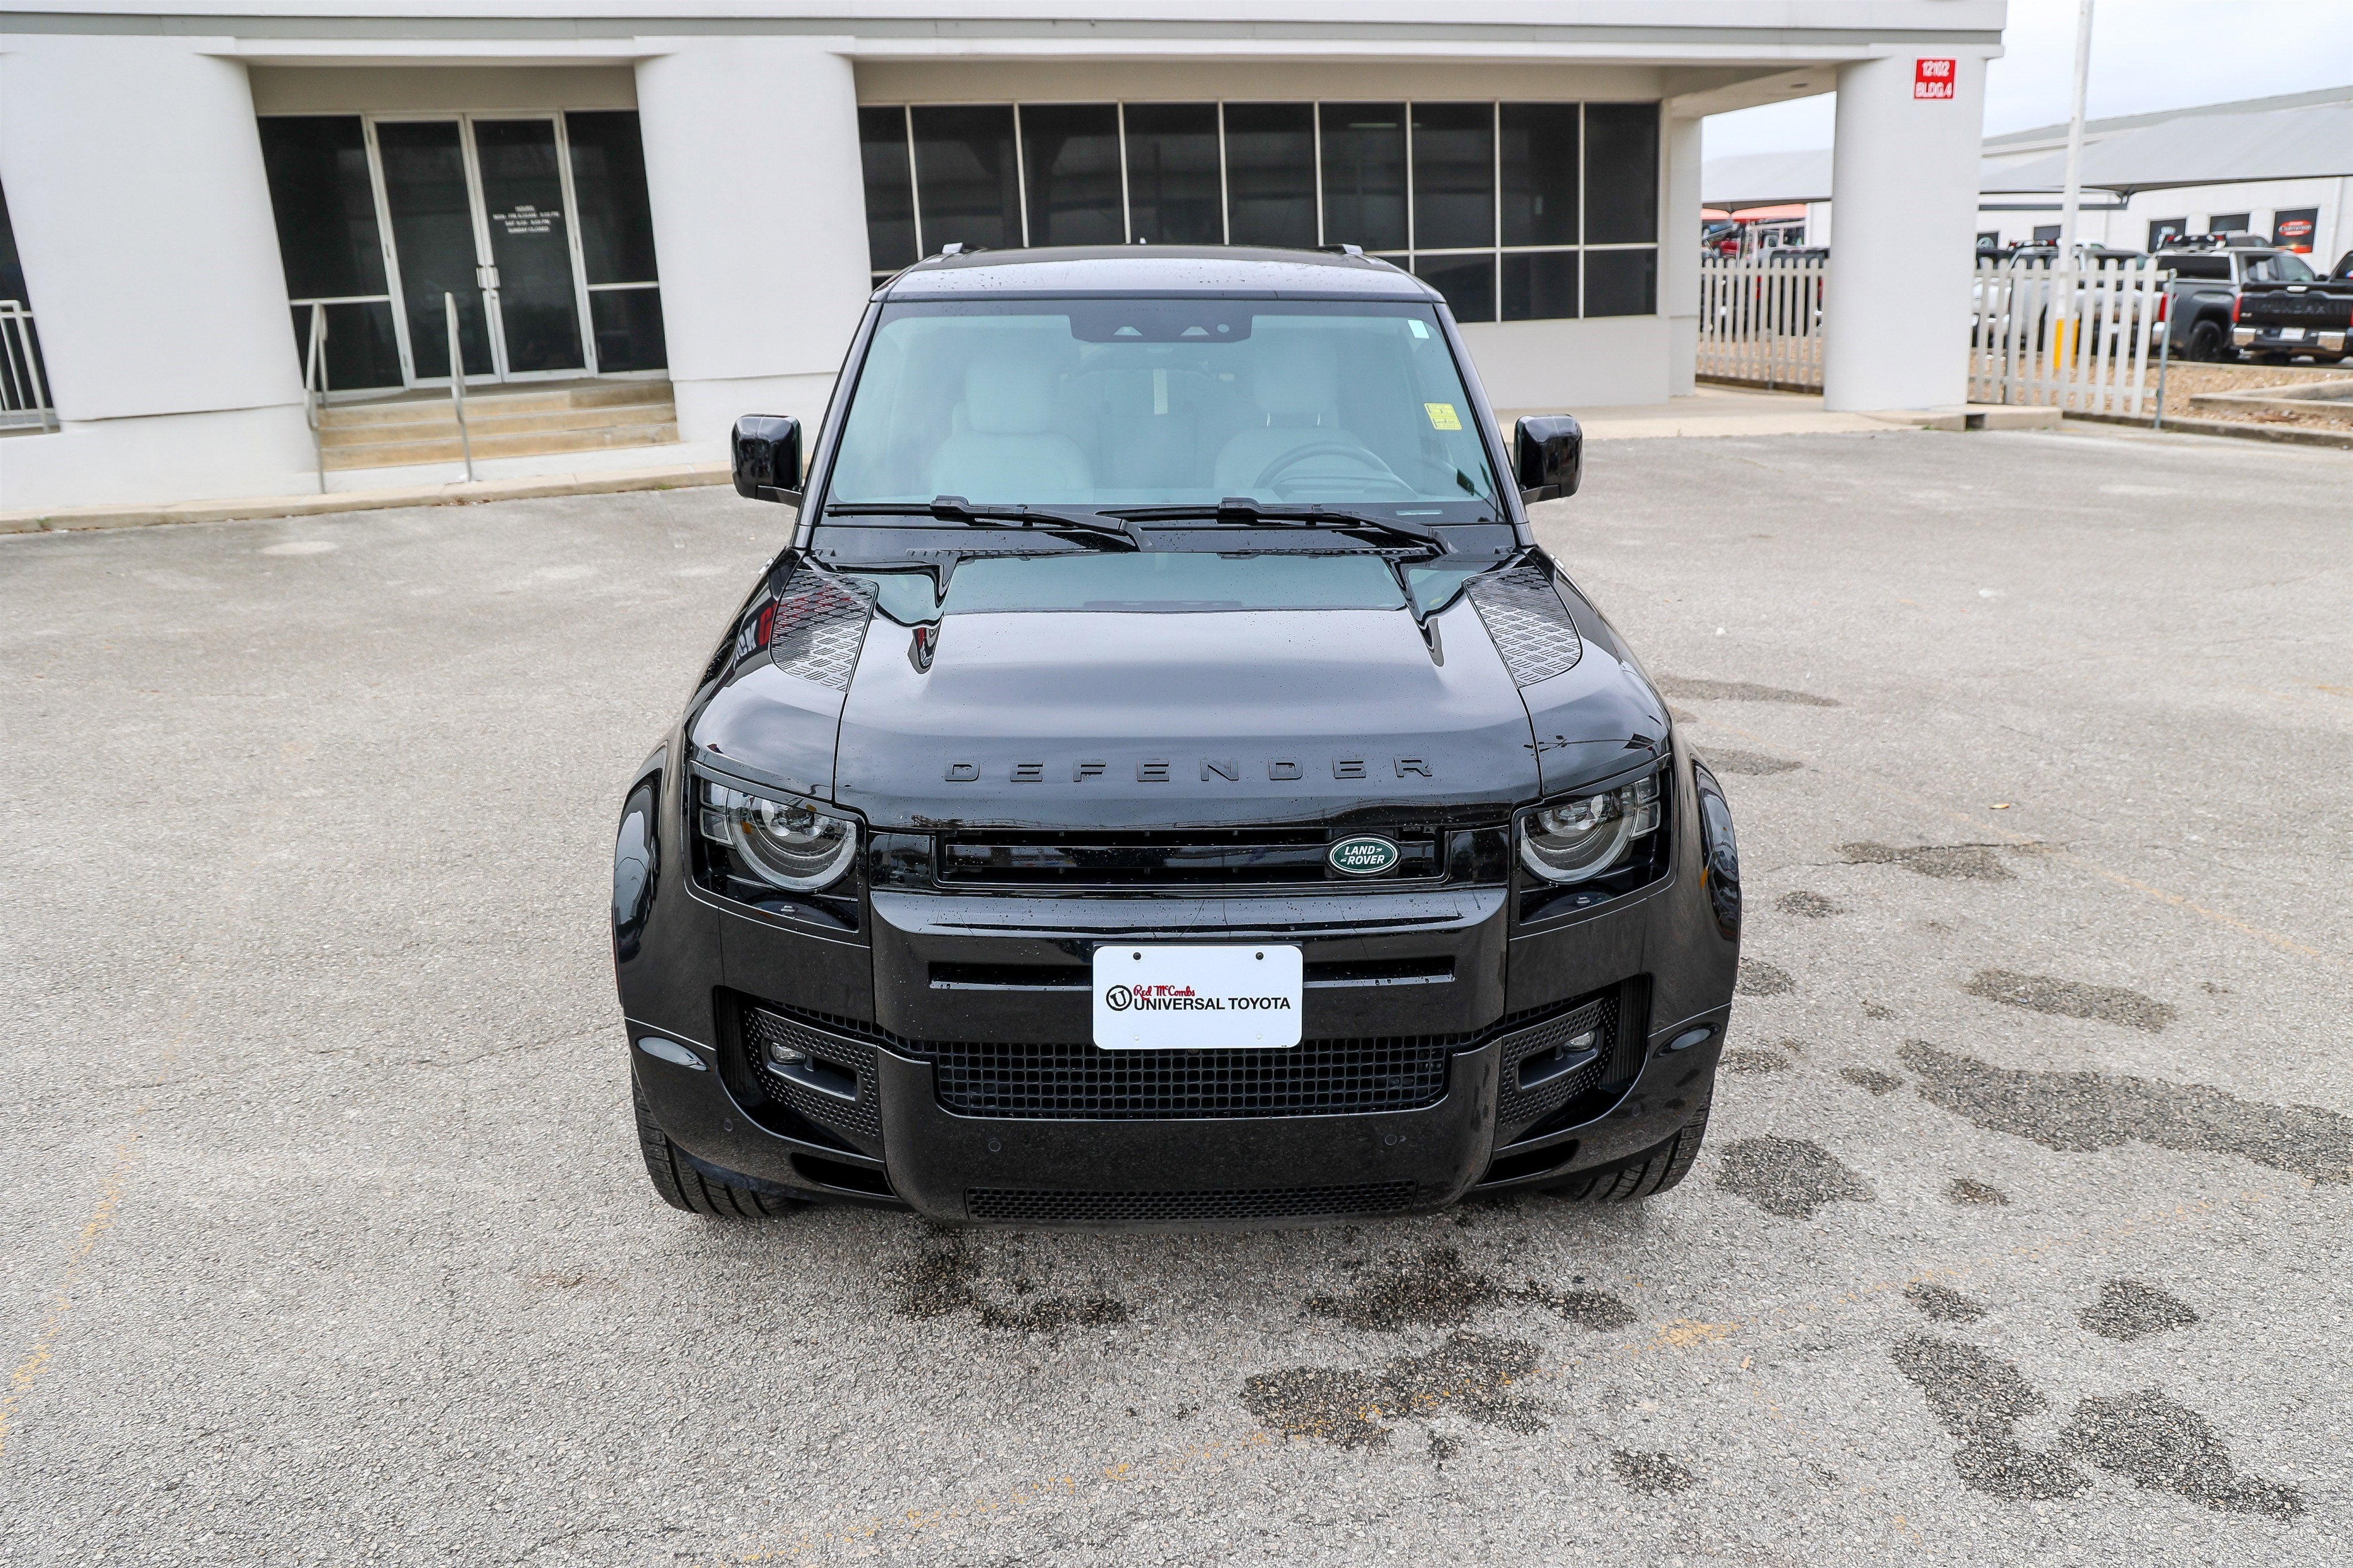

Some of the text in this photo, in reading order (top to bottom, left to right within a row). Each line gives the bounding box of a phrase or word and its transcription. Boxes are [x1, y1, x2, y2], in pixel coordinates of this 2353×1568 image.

[1922, 61, 1950, 77] 12102
[944, 756, 1433, 783] DEFENDER
[1344, 845, 1375, 855] LAND
[1347, 855, 1385, 865] ROVER
[1133, 984, 1195, 1001] Red McCombs
[1134, 997, 1291, 1010] UNIVERSAL TOYOTA
